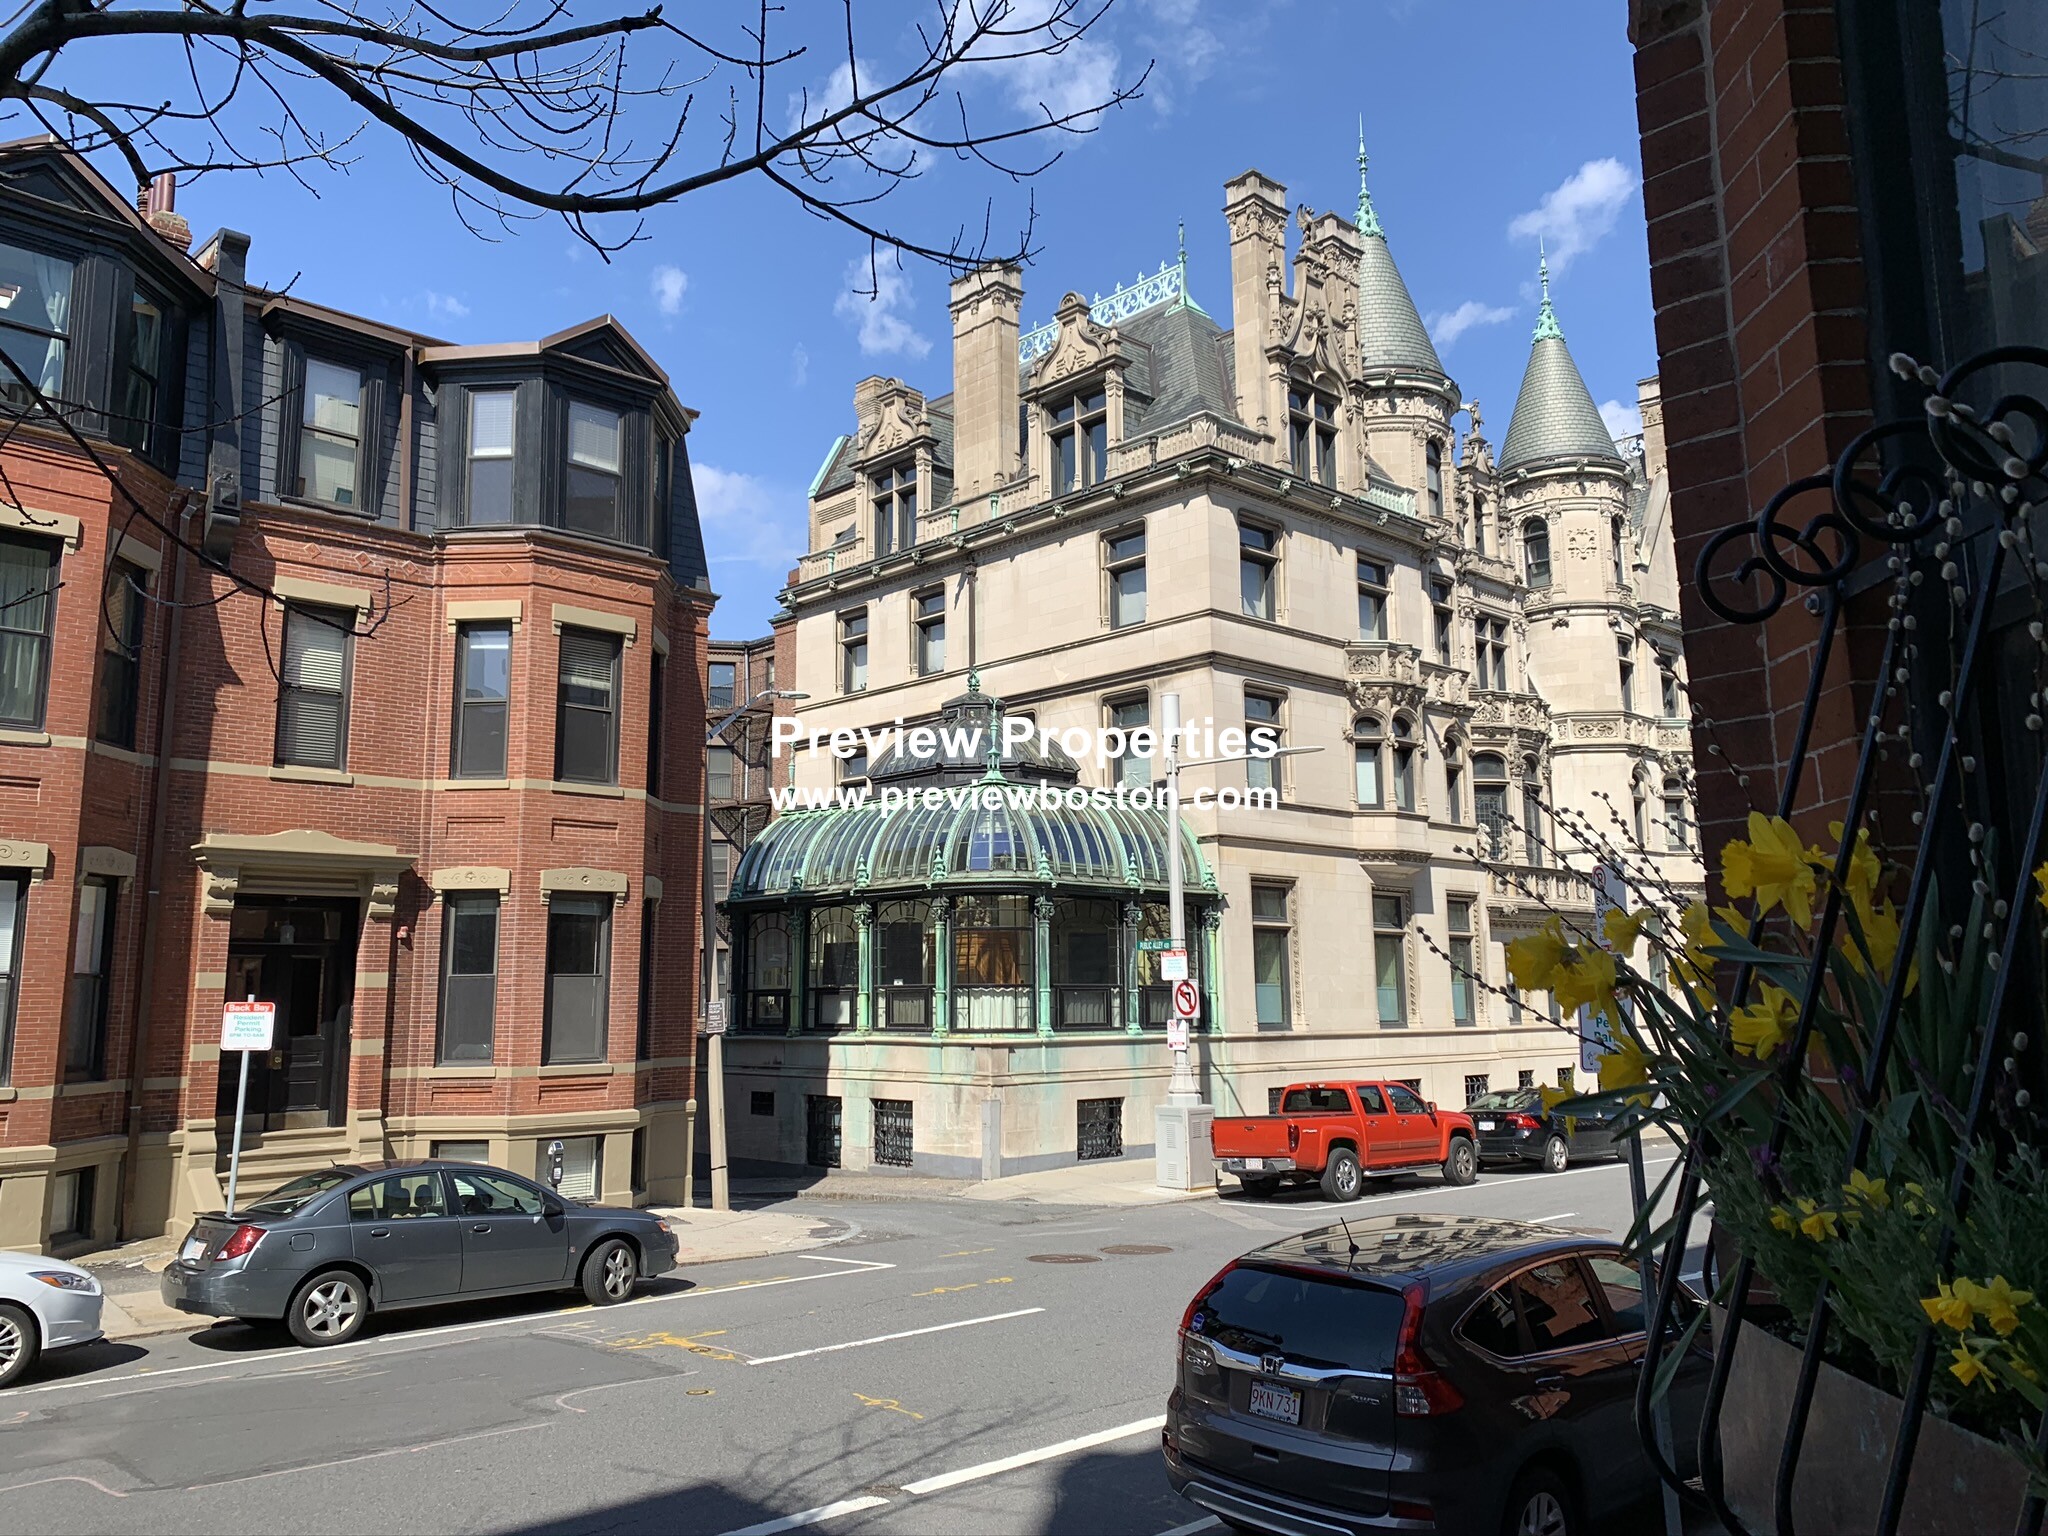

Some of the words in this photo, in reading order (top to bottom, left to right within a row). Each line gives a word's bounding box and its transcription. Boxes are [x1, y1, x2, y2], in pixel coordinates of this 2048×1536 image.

[1139, 941, 1152, 949] PUBLIC
[1152, 941, 1164, 949] ALLEY
[228, 1003, 251, 1012] Back
[253, 1003, 270, 1012] Bay
[1251, 1389, 1274, 1410] 9KN
[1275, 1393, 1298, 1416] 731
